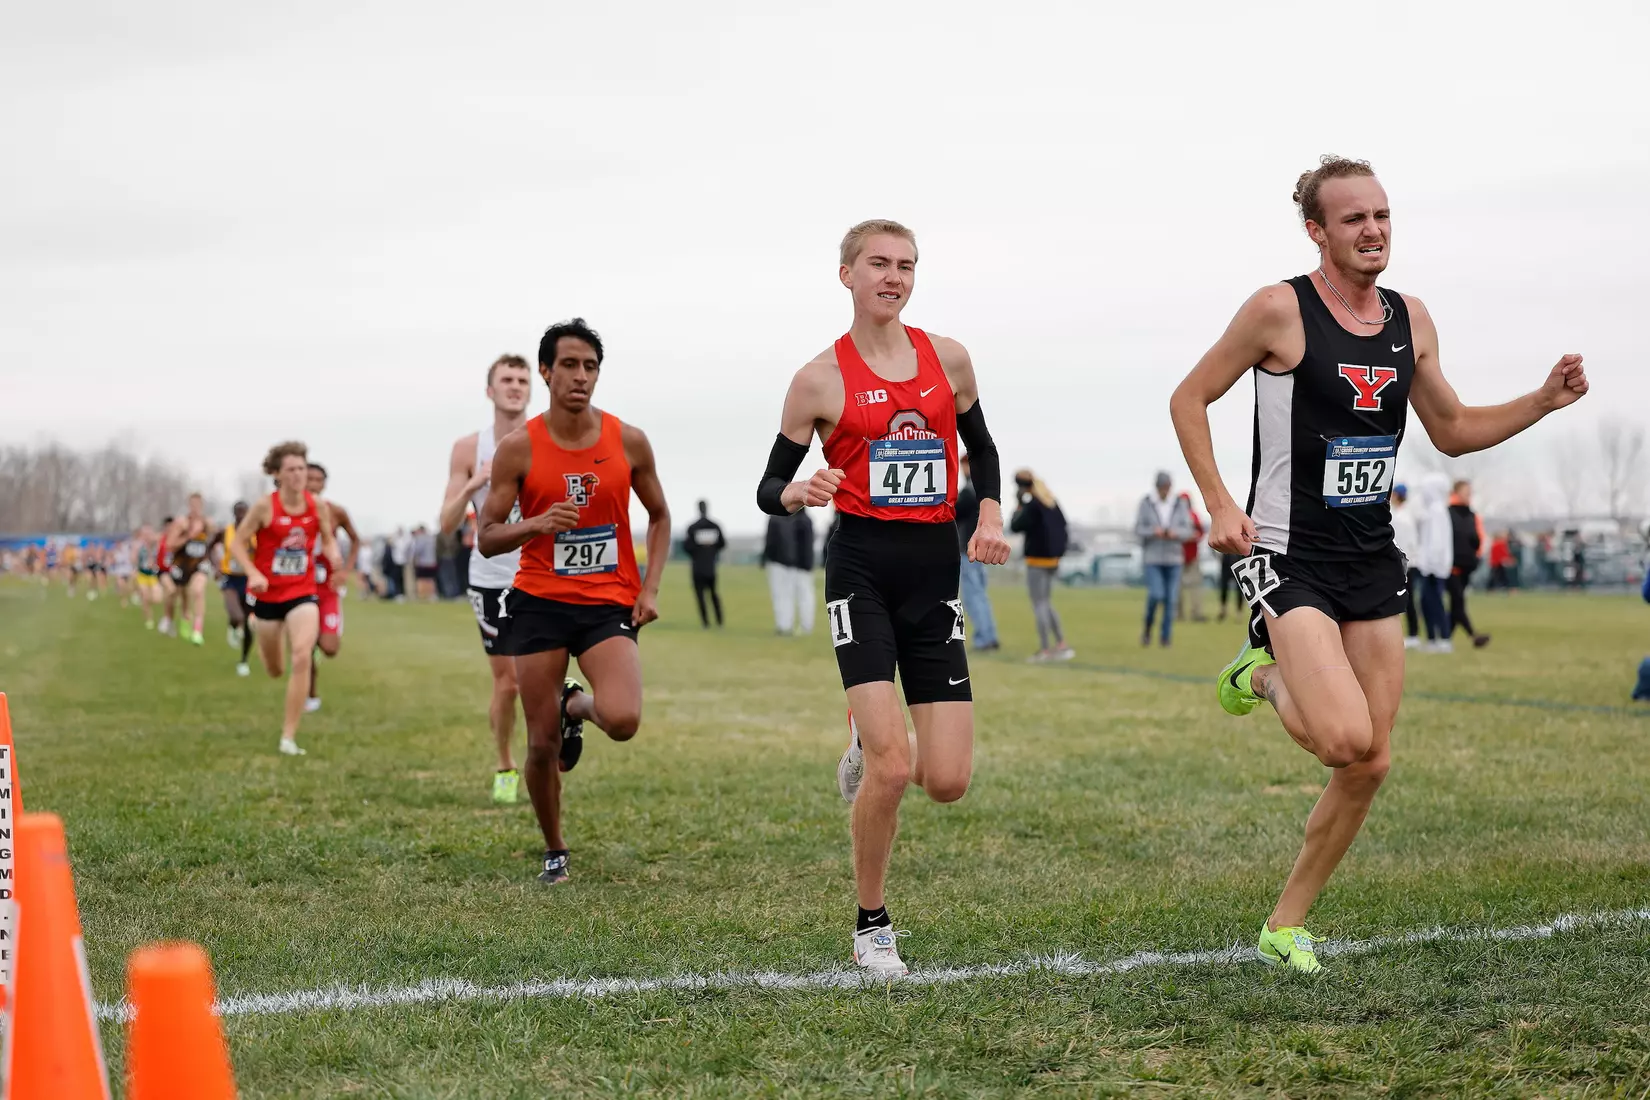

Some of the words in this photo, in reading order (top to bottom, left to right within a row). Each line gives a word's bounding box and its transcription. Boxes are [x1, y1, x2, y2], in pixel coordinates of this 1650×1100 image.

[1338, 363, 1397, 411] Y
[882, 462, 936, 494] 471
[1337, 460, 1386, 494] 552
[563, 542, 607, 567] 297
